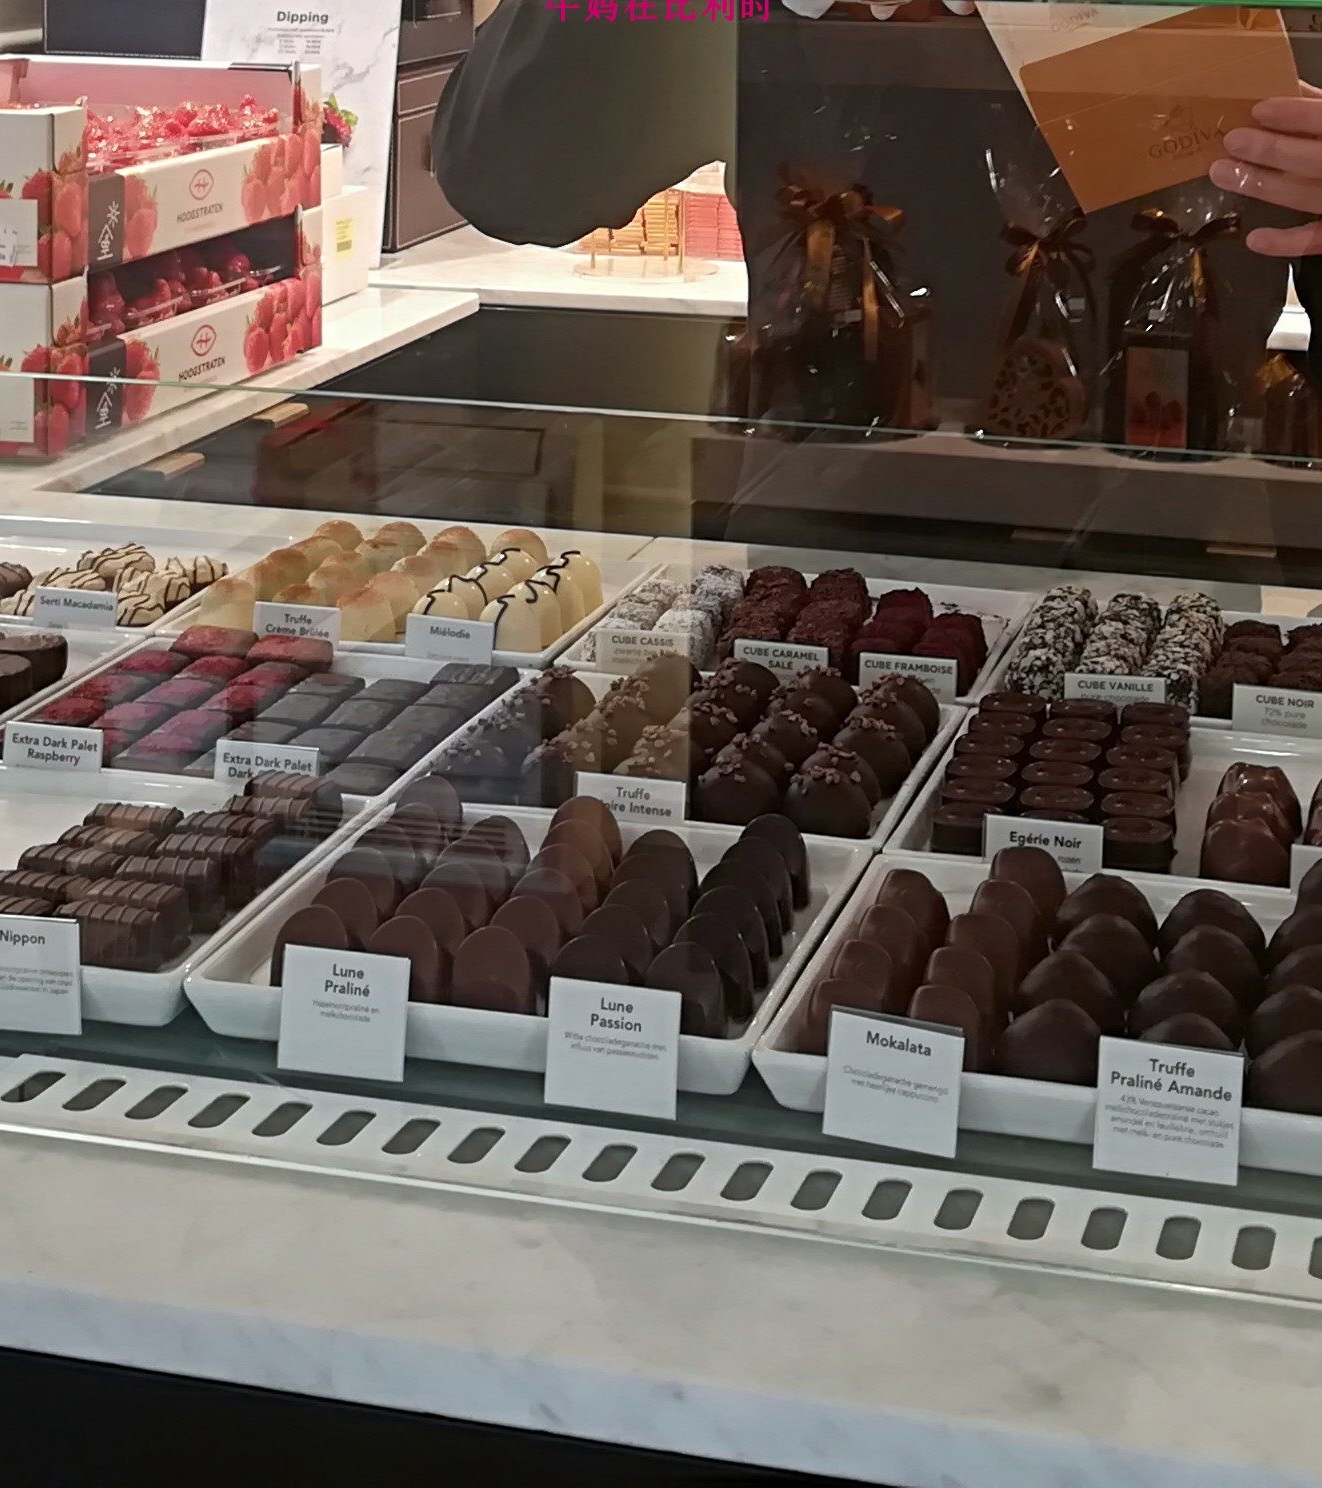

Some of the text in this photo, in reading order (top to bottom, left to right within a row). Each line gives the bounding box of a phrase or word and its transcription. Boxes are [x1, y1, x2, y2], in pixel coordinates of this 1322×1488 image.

[277, 11, 329, 24] Dipping
[177, 203, 224, 224] HOOGSTRATEN
[178, 356, 226, 382] HOOGSTRATEN
[40, 596, 114, 612] Serti Macadamia
[284, 613, 312, 625] Truffe
[265, 623, 297, 636] Crème
[430, 625, 470, 639] Miélodie
[611, 635, 674, 648] CUBE CASSIS
[743, 646, 819, 661] CUBE CARAMEL
[864, 659, 953, 676] CUBE FRAMBOISE
[1078, 680, 1154, 692] CUBE VANILLE
[1256, 695, 1314, 709] CUBE NOIR
[12, 733, 98, 752] Extra Dark Palet
[27, 749, 81, 766] Raspberry
[223, 753, 312, 772] Extra Dark Palet
[228, 767, 253, 779] Dark
[616, 786, 651, 800] Truffe
[630, 802, 672, 817] Intense
[1010, 831, 1082, 849] Egérie Noir
[0, 929, 46, 946] Nippon
[333, 964, 364, 980] Lune
[324, 980, 371, 997] Praliné
[600, 997, 634, 1014] Lune
[590, 1013, 642, 1032] Passion
[866, 1030, 932, 1057] Mokalata
[1149, 1058, 1195, 1078] Truffe
[1110, 1071, 1232, 1101] Praliné Amande
